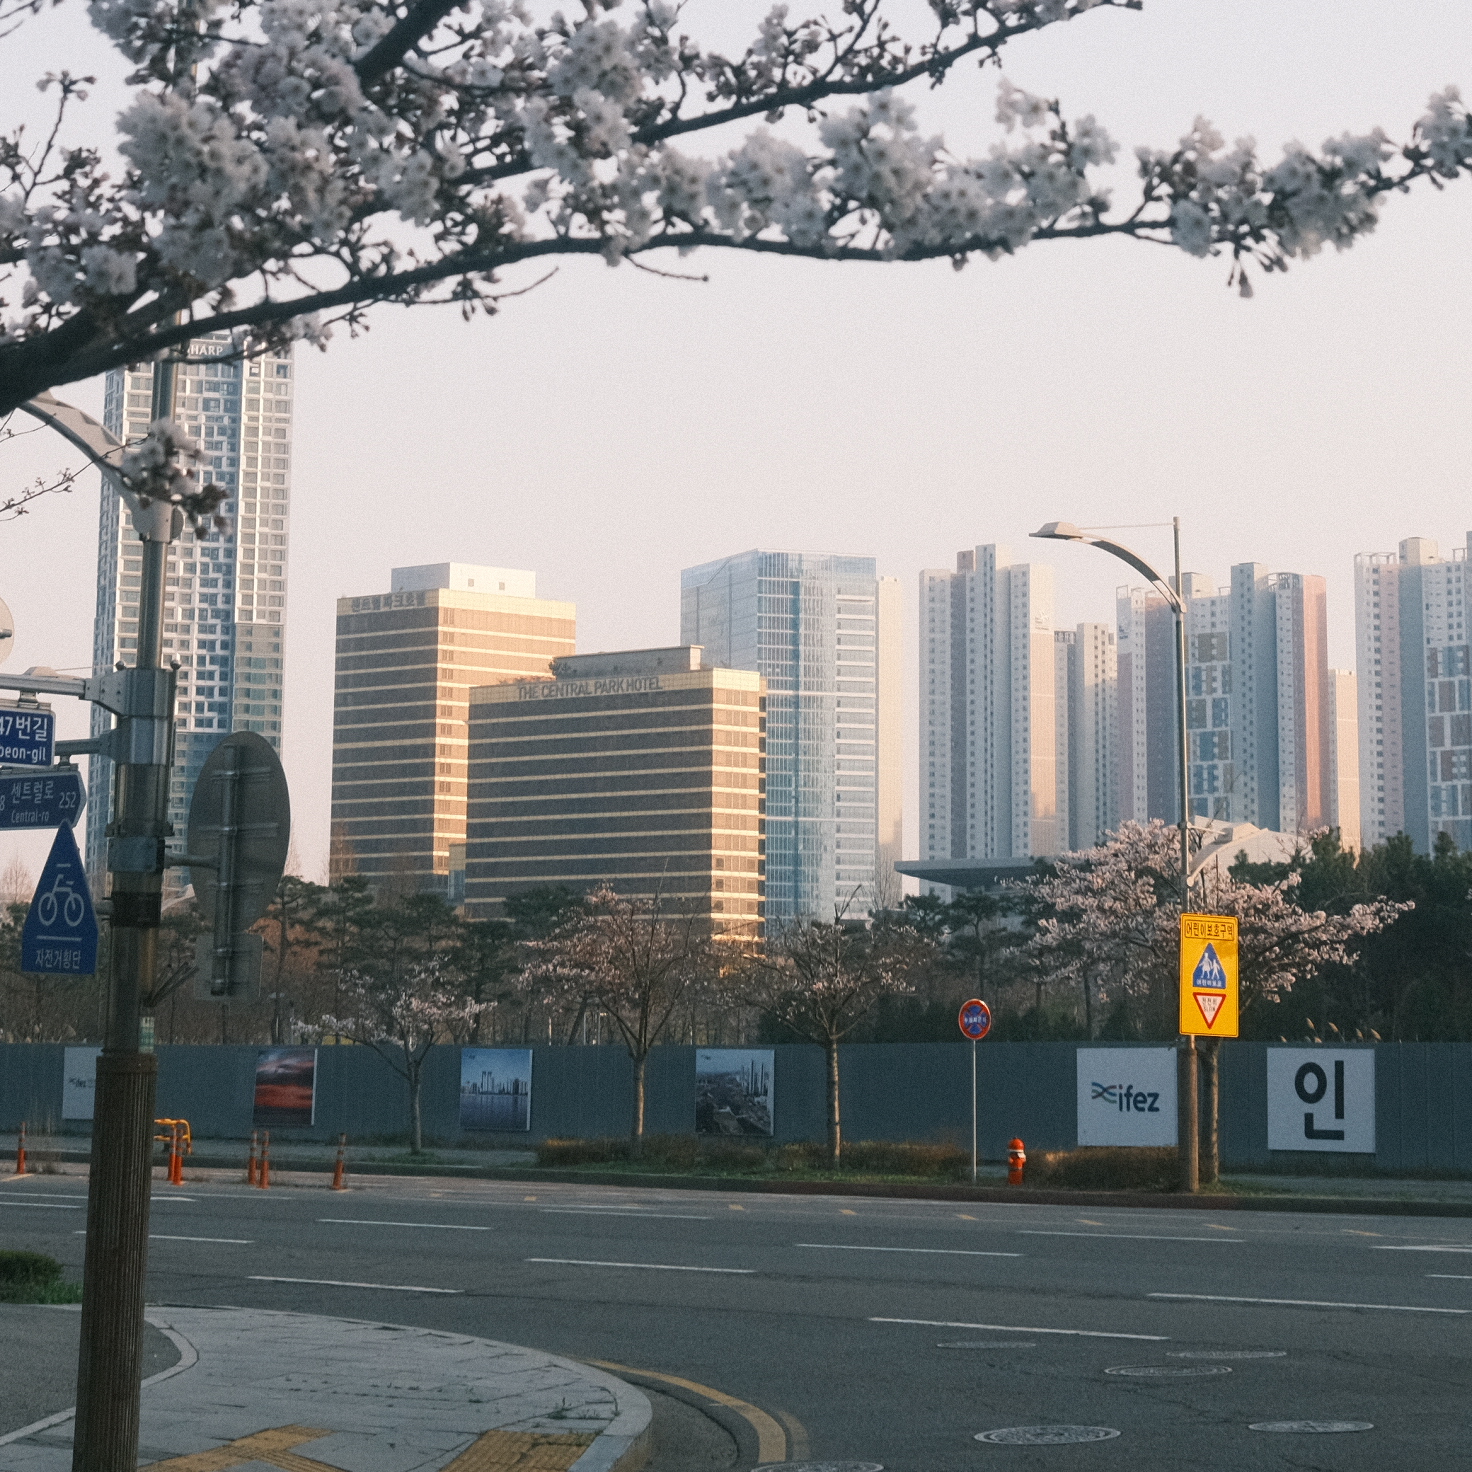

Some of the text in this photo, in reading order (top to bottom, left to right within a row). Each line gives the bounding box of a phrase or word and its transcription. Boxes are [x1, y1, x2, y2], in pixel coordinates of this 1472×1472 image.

[187, 345, 223, 356] HARP
[518, 677, 663, 700] THE CENTRAL PARK HOTEL
[11, 780, 54, 804] 센트럴로
[58, 791, 77, 809] 252
[11, 809, 50, 824] Central-ro
[1186, 922, 1233, 939] 어린이보호구역
[35, 948, 81, 969] 자전거횡단
[1118, 1084, 1160, 1113] ifez
